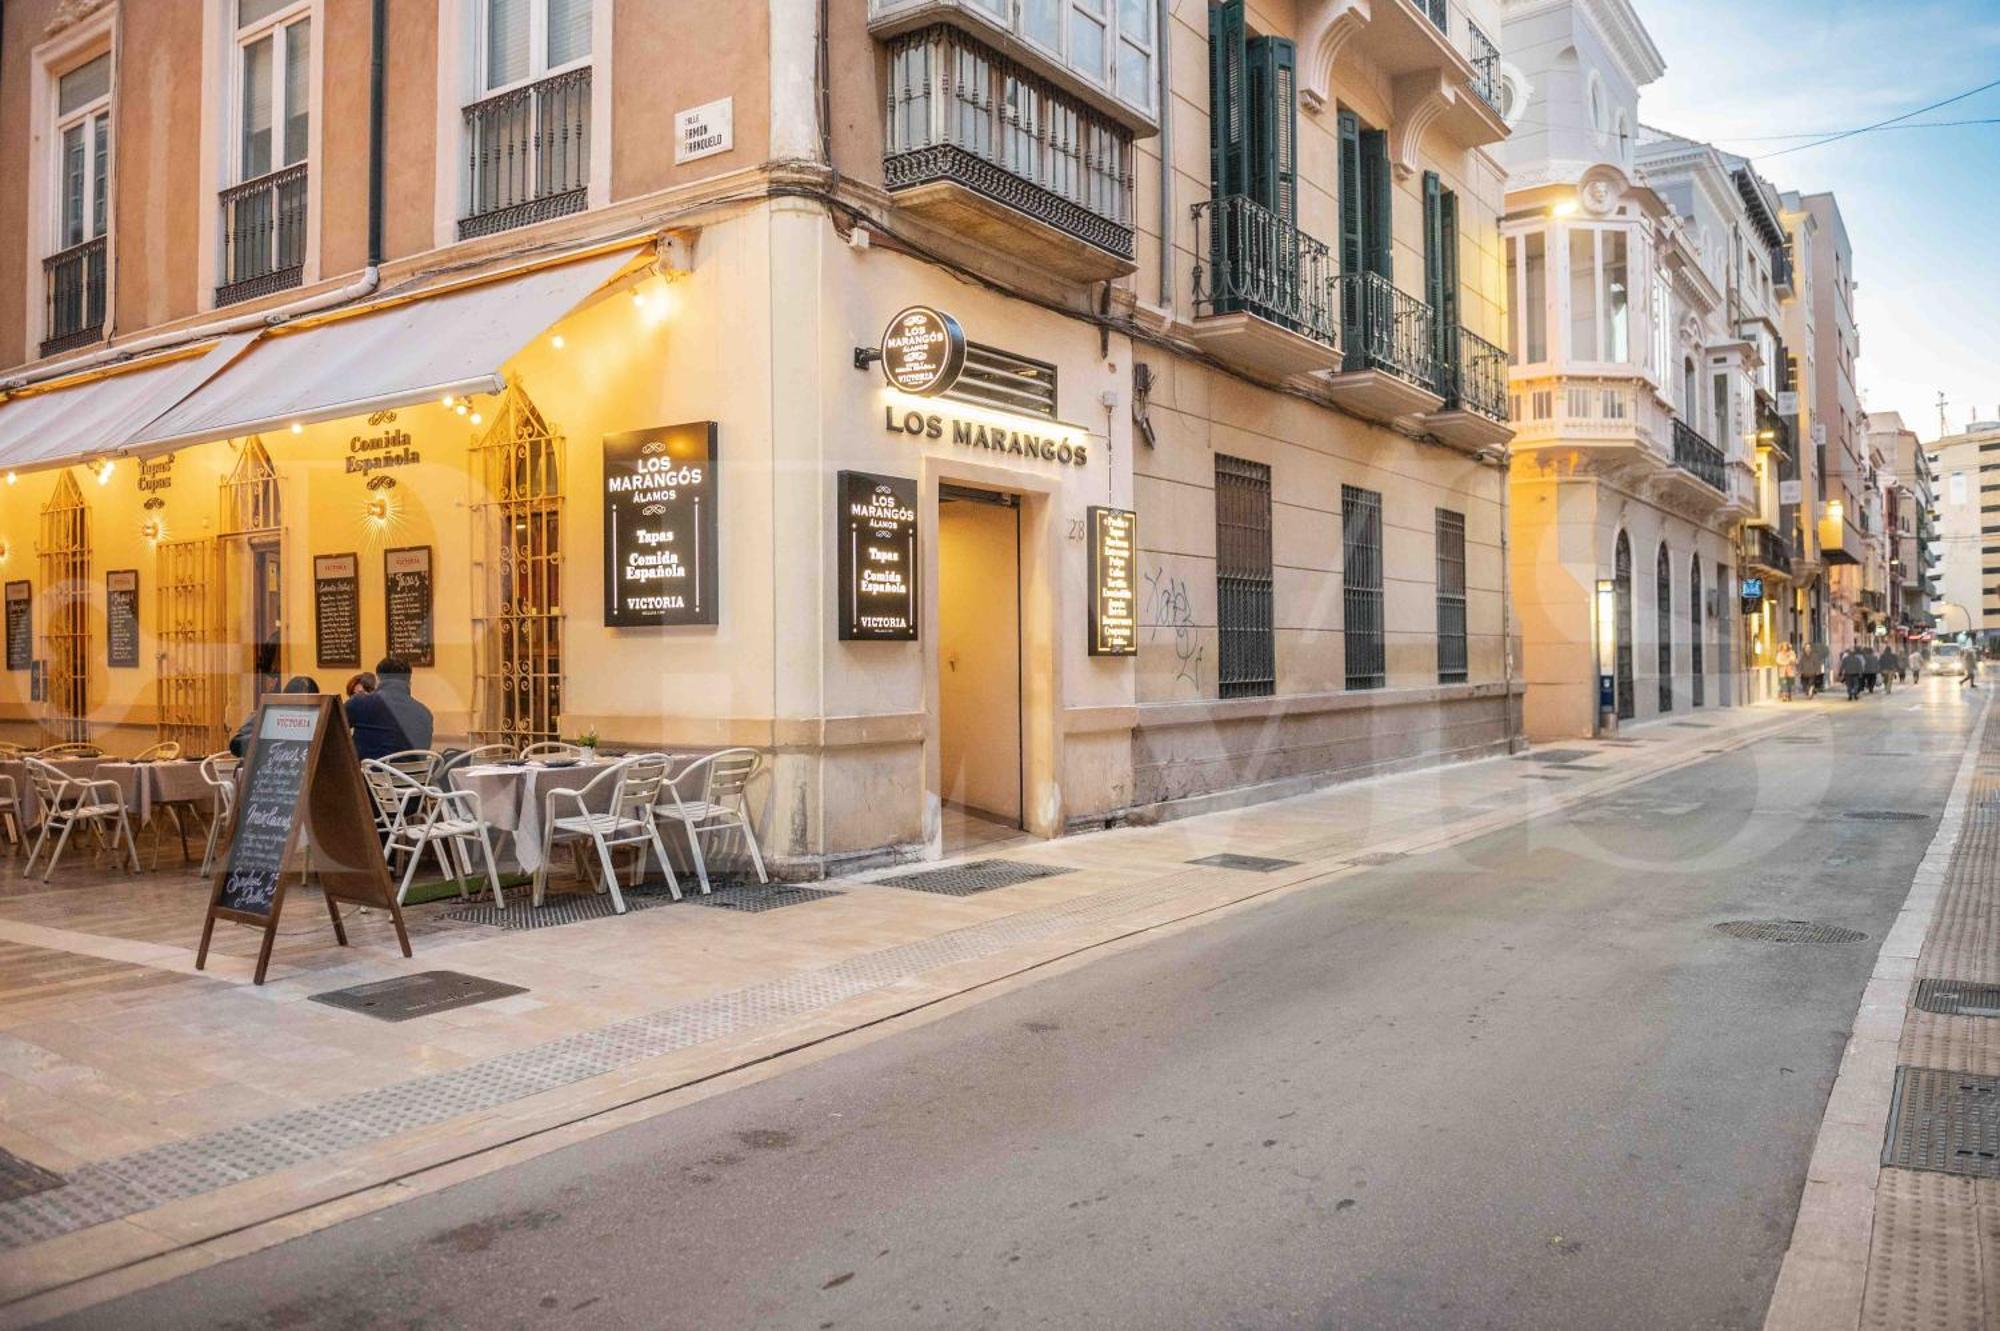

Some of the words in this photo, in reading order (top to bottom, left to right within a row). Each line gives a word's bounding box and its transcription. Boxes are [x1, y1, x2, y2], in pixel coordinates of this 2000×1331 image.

[905, 327, 926, 337] LOS
[350, 429, 411, 453] Comida
[886, 406, 942, 439] LOS
[952, 418, 1087, 466] MARANGÓS
[345, 448, 420, 476] Española
[637, 456, 671, 475] LOS
[609, 467, 703, 492] MARANGÓS
[633, 489, 676, 503] ÁLAMOS
[872, 495, 895, 507] LOS
[851, 503, 914, 521] MARANGÓS
[870, 519, 898, 529] ÁLAMOS
[1067, 519, 1085, 541] 28
[637, 530, 674, 545] Tapas
[629, 553, 679, 566] Comida
[869, 547, 898, 562] Tapas
[626, 565, 686, 582] Española
[863, 569, 901, 583] Comida
[861, 581, 906, 595] Española
[627, 596, 684, 610] VICTORIA
[861, 617, 907, 628] VICTORIA
